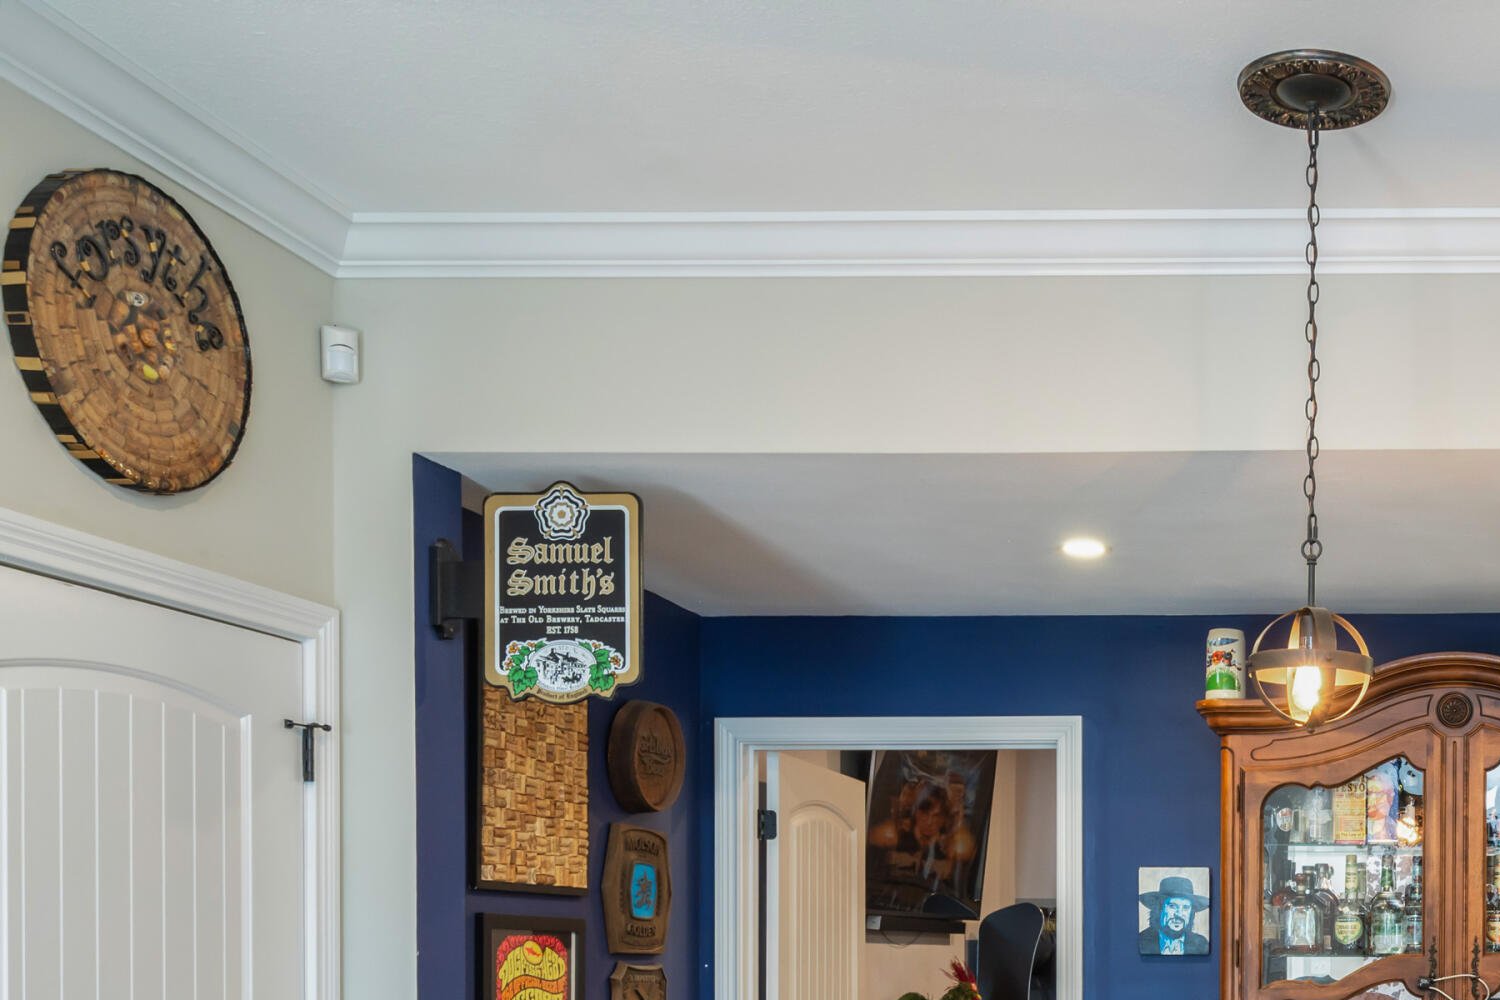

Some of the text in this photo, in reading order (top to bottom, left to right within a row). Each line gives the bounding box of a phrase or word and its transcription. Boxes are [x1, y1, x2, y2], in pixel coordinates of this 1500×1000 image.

[506, 536, 614, 565] Samuel
[506, 567, 615, 600] Smith's
[528, 615, 544, 624] OLD
[584, 615, 625, 623] TADCASTER
[564, 626, 579, 634] 1758
